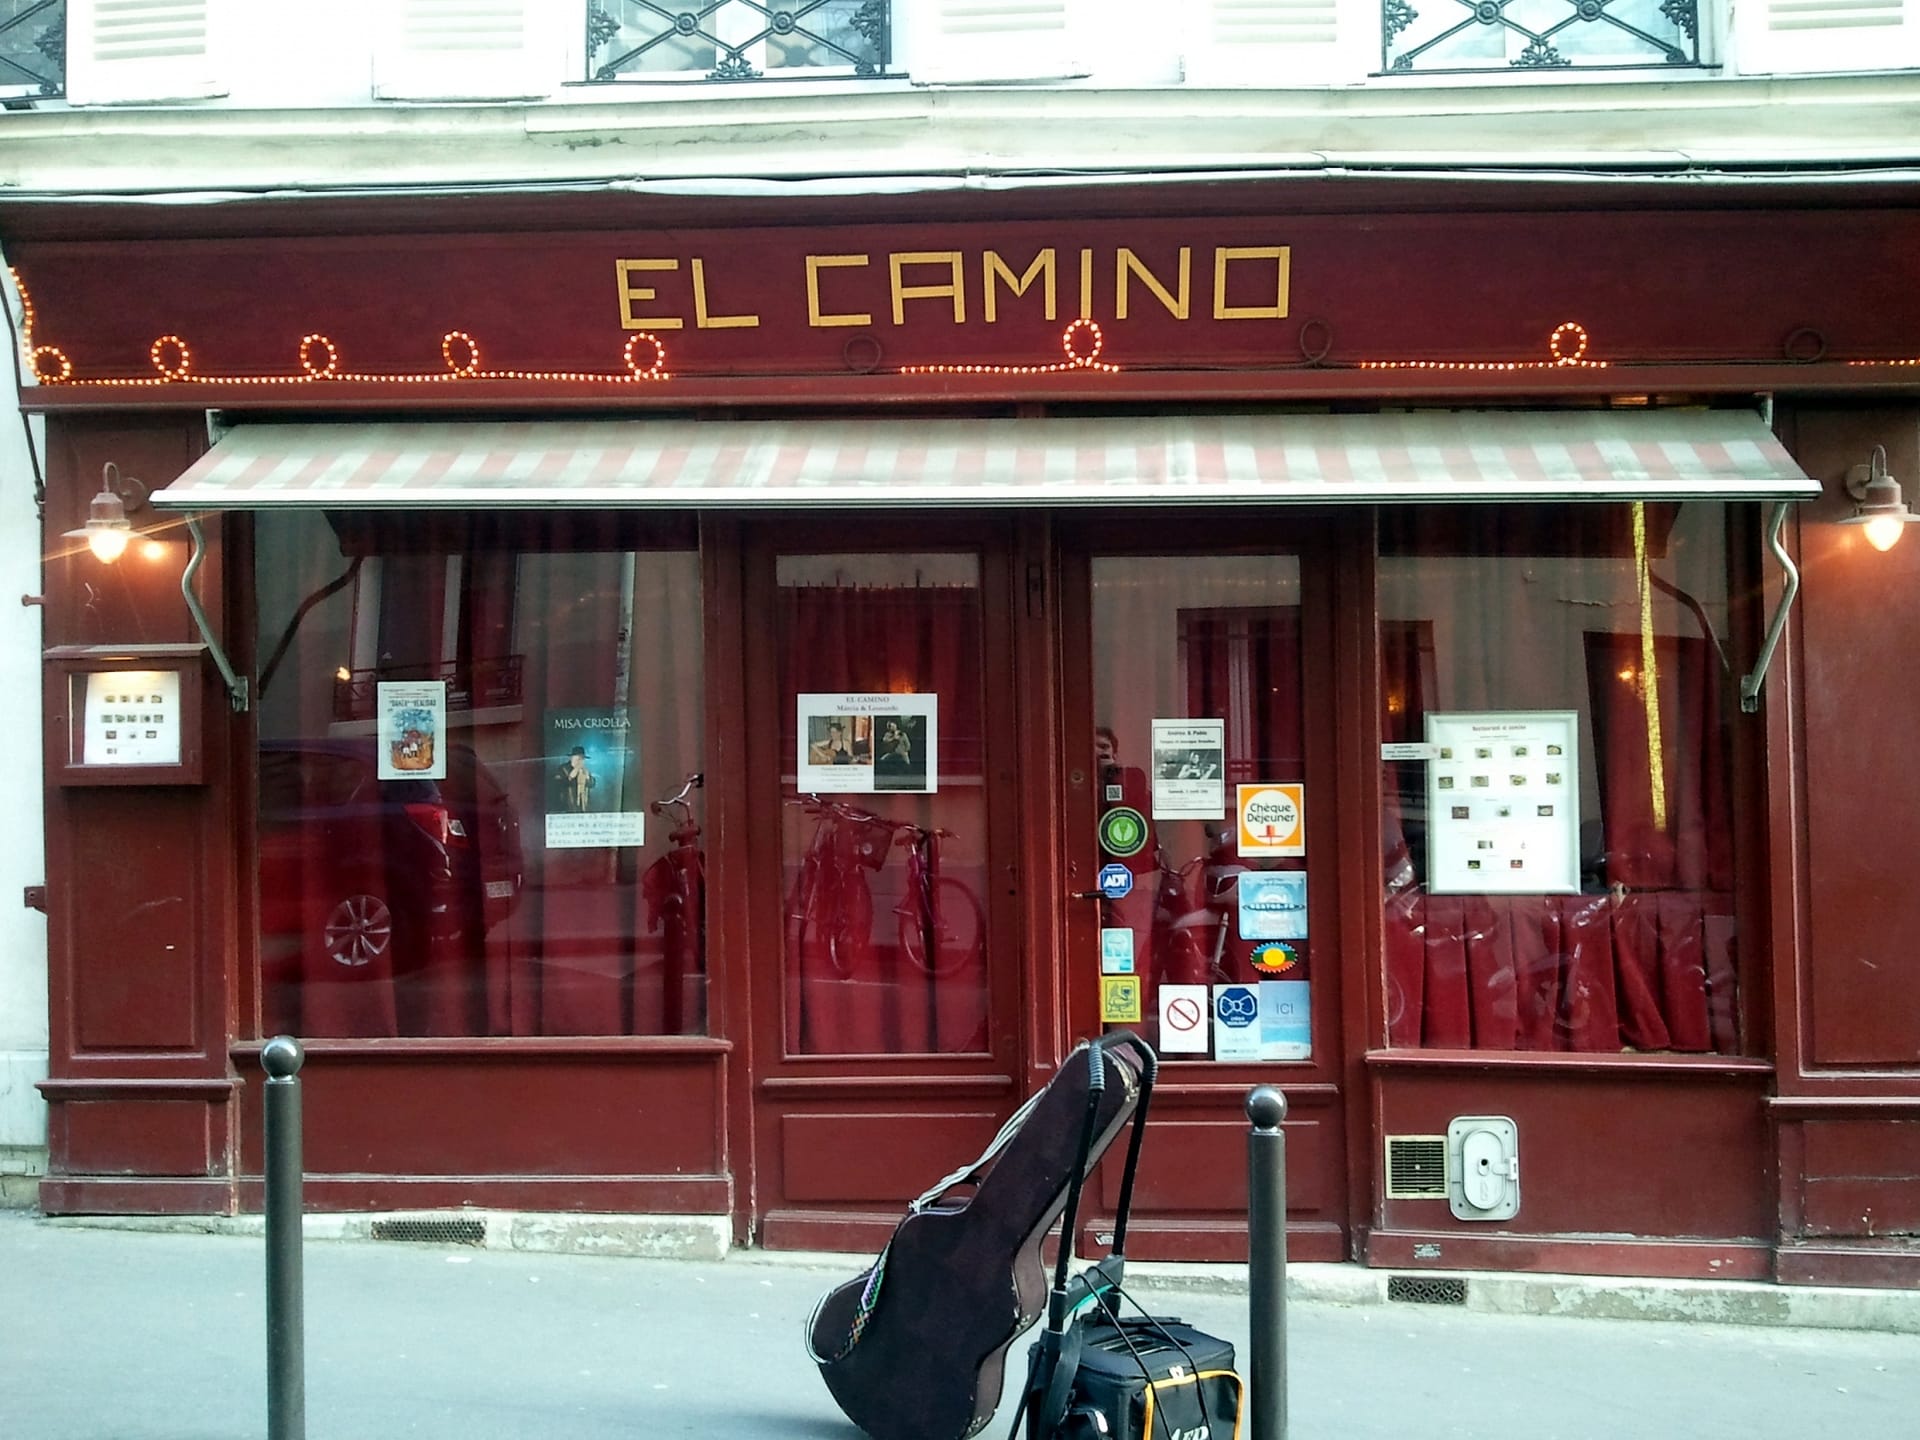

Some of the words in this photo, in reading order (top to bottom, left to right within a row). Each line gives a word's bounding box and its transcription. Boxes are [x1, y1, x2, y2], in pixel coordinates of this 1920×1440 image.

[615, 258, 759, 330] EL
[805, 245, 1290, 327] CAMINO
[554, 718, 582, 729] MISA
[583, 717, 632, 729] CRIOLLA
[1249, 802, 1292, 813] Chèque
[1103, 873, 1128, 888] ADT
[1275, 1002, 1294, 1015] ICI
